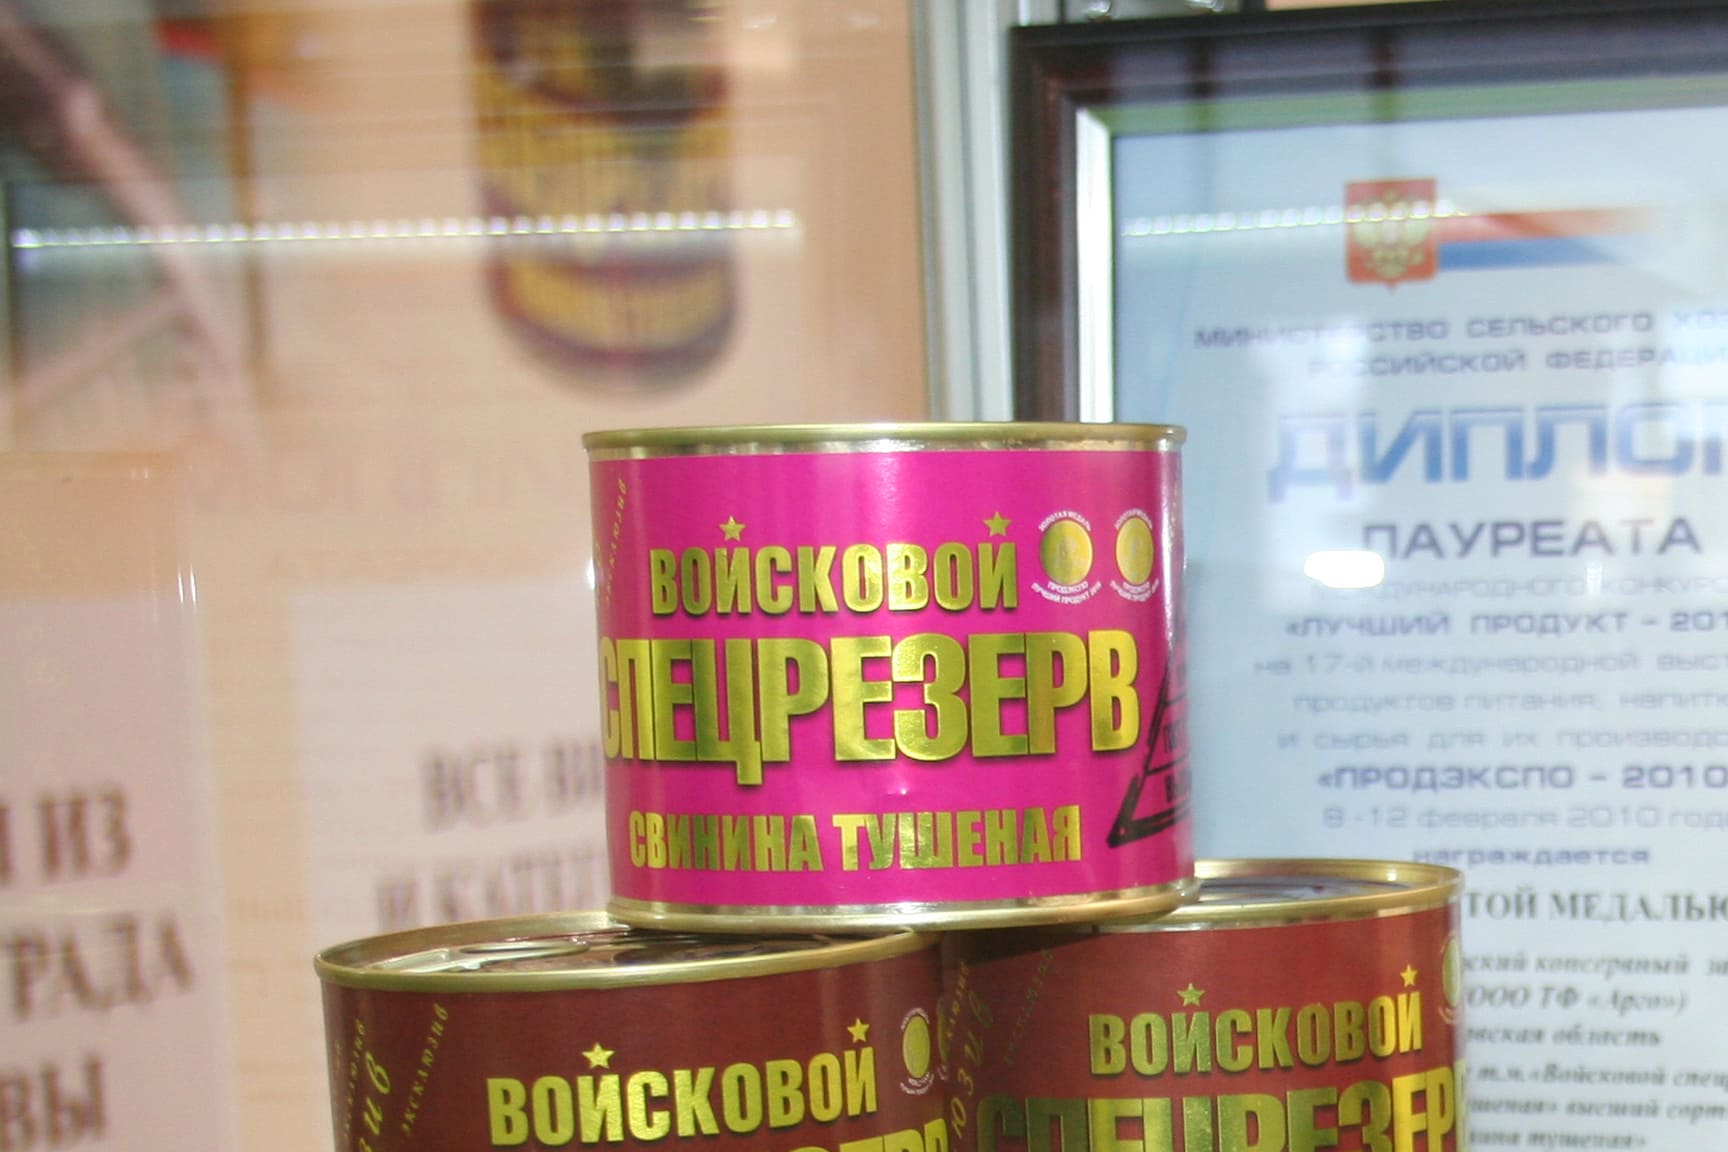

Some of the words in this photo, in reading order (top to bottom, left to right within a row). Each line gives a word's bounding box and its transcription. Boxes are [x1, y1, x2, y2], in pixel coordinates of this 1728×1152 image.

[1466, 312, 1653, 340] СЕЛЬСКОГО
[650, 541, 1018, 616] ВОЙСКОВОЙ
[1470, 611, 1628, 637] ПРОДУКТ
[600, 629, 1139, 786] СПЕЦРЕЗЕРВ
[36, 782, 135, 880] ИЗ
[629, 813, 824, 872] СВИНИНА
[832, 805, 1082, 872] ТУШЕНАЯ
[1417, 804, 1559, 833] февраля
[1567, 803, 1661, 829] 2010
[1412, 847, 1651, 868] награждается
[1089, 990, 1422, 1076] ВОЙСКОВОЙ
[486, 1045, 878, 1147] ВОЙСКОВОЙ
